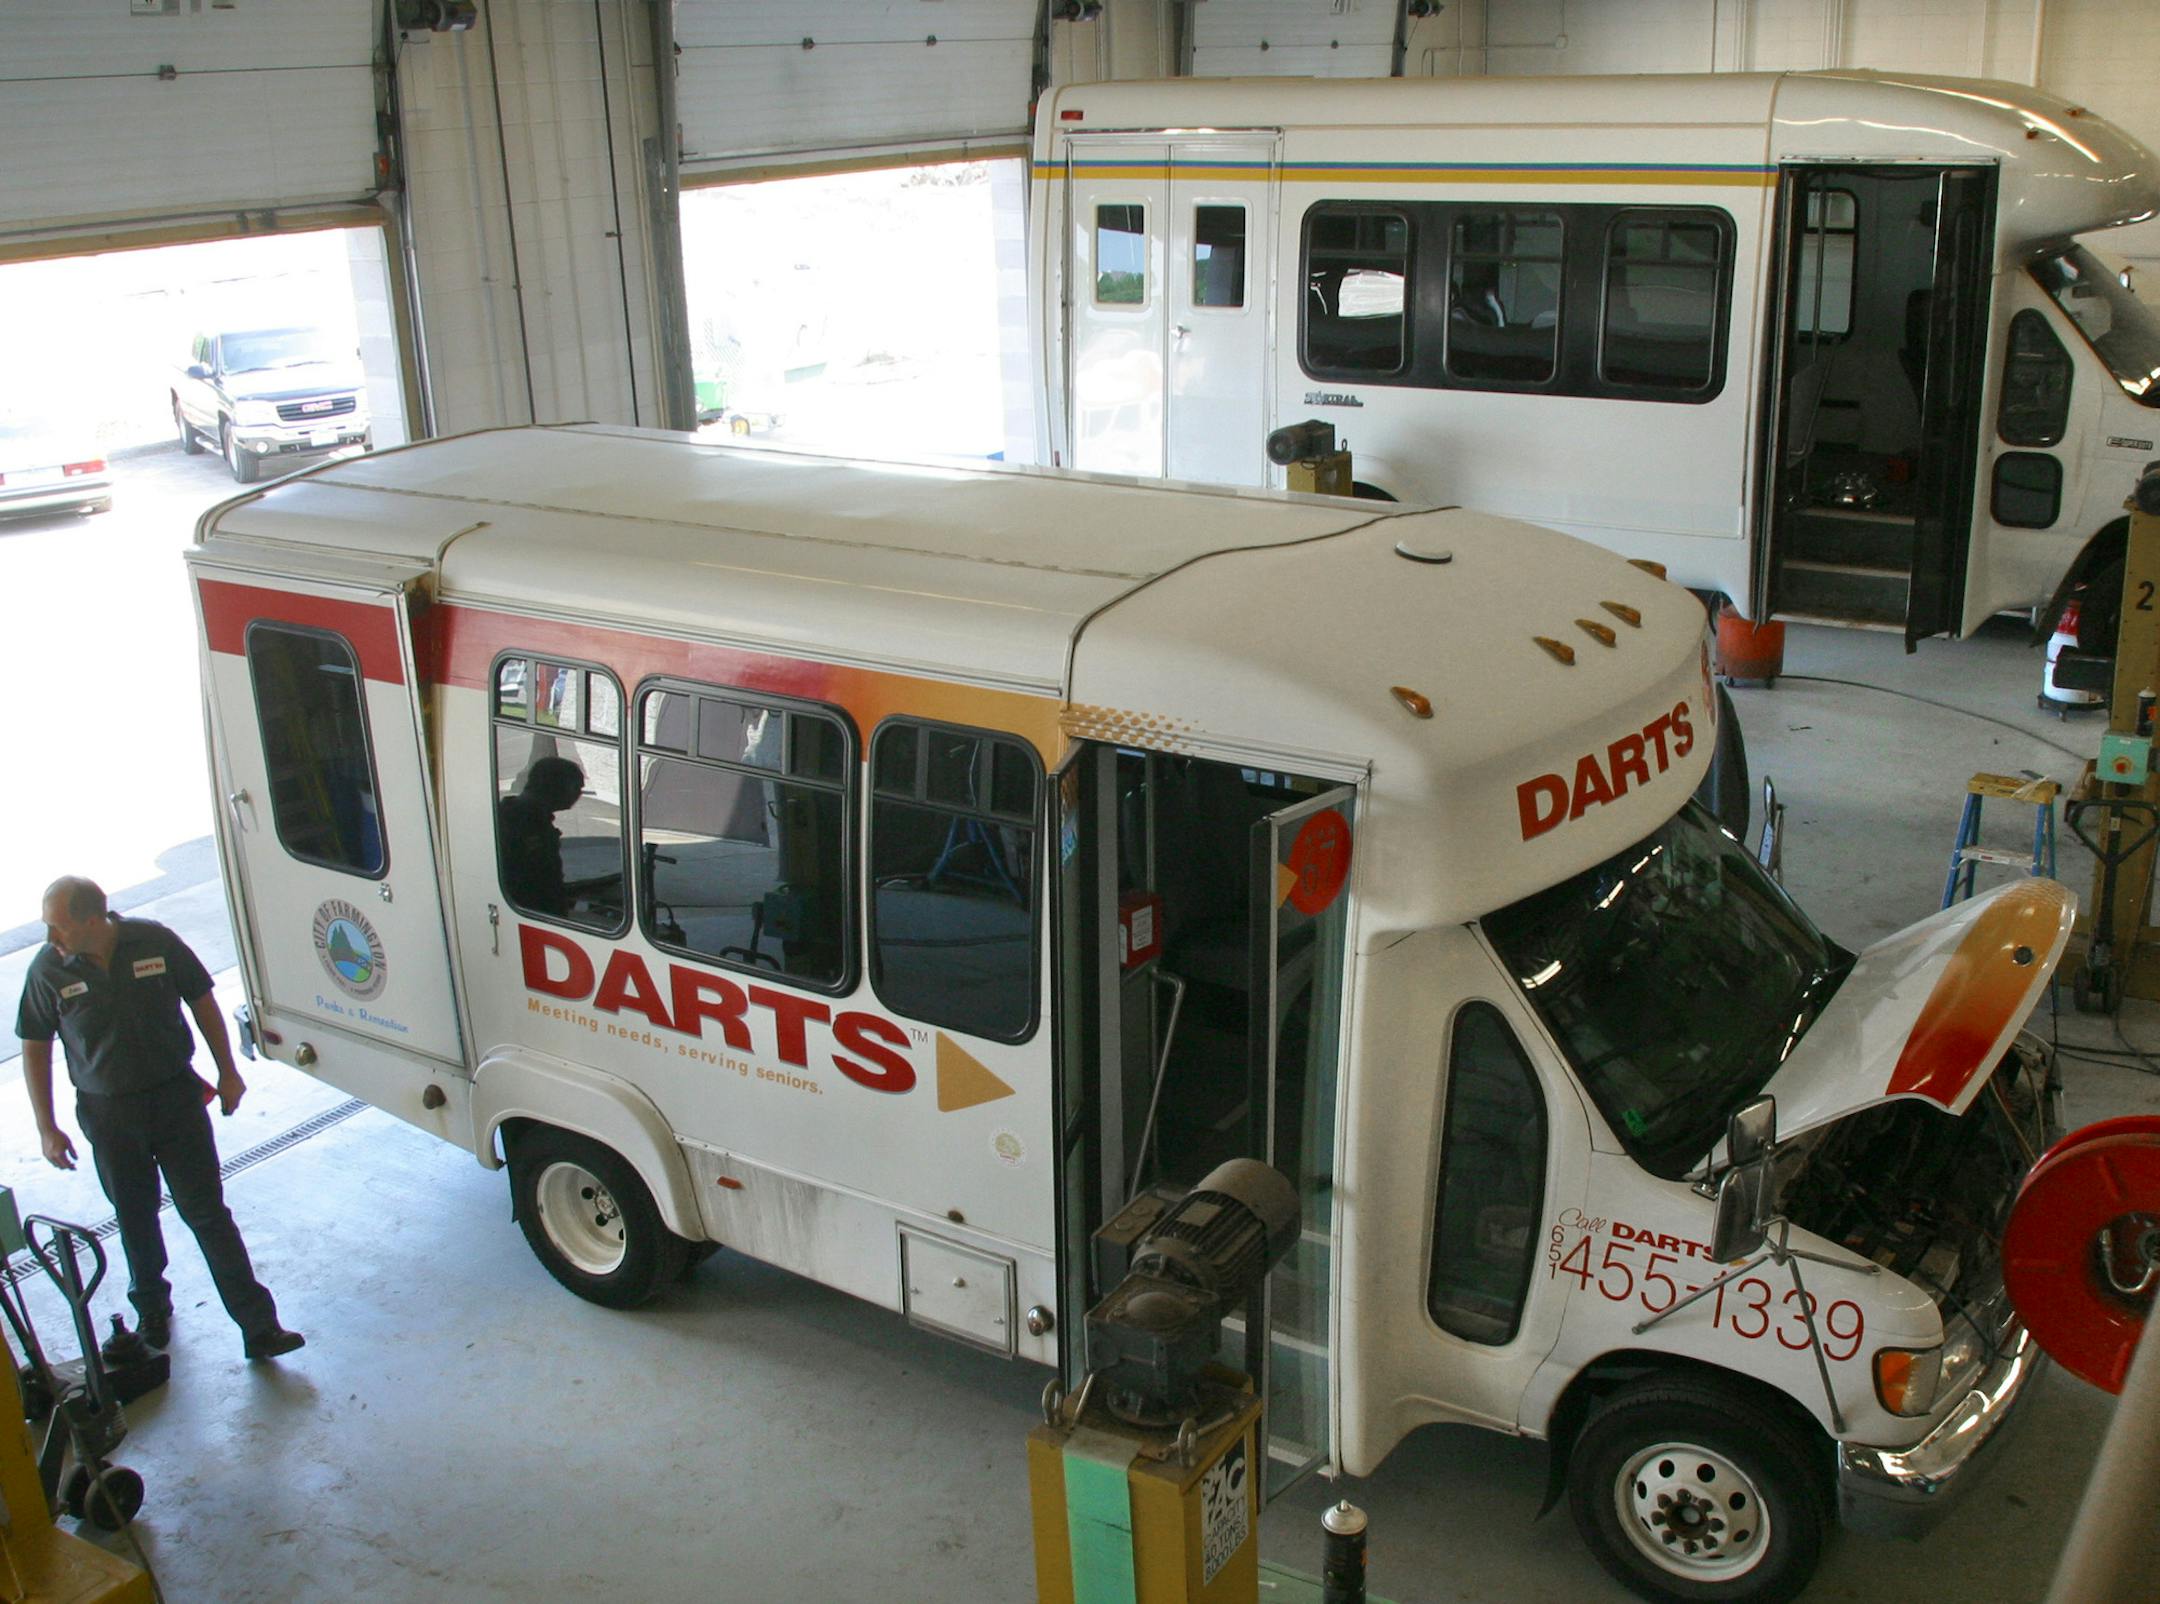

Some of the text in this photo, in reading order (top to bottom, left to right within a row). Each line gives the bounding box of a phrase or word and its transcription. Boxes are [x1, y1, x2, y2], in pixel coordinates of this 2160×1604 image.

[2136, 581, 2154, 611] 2
[1516, 701, 1694, 842] DARTS
[331, 901, 387, 971] FARMINGTON
[518, 922, 917, 1095] DARTS
[528, 997, 823, 1095] Meeting needs, serving seniors.
[1559, 1207, 1714, 1262] Call DARTS
[1559, 1235, 1865, 1362] 455-1339
